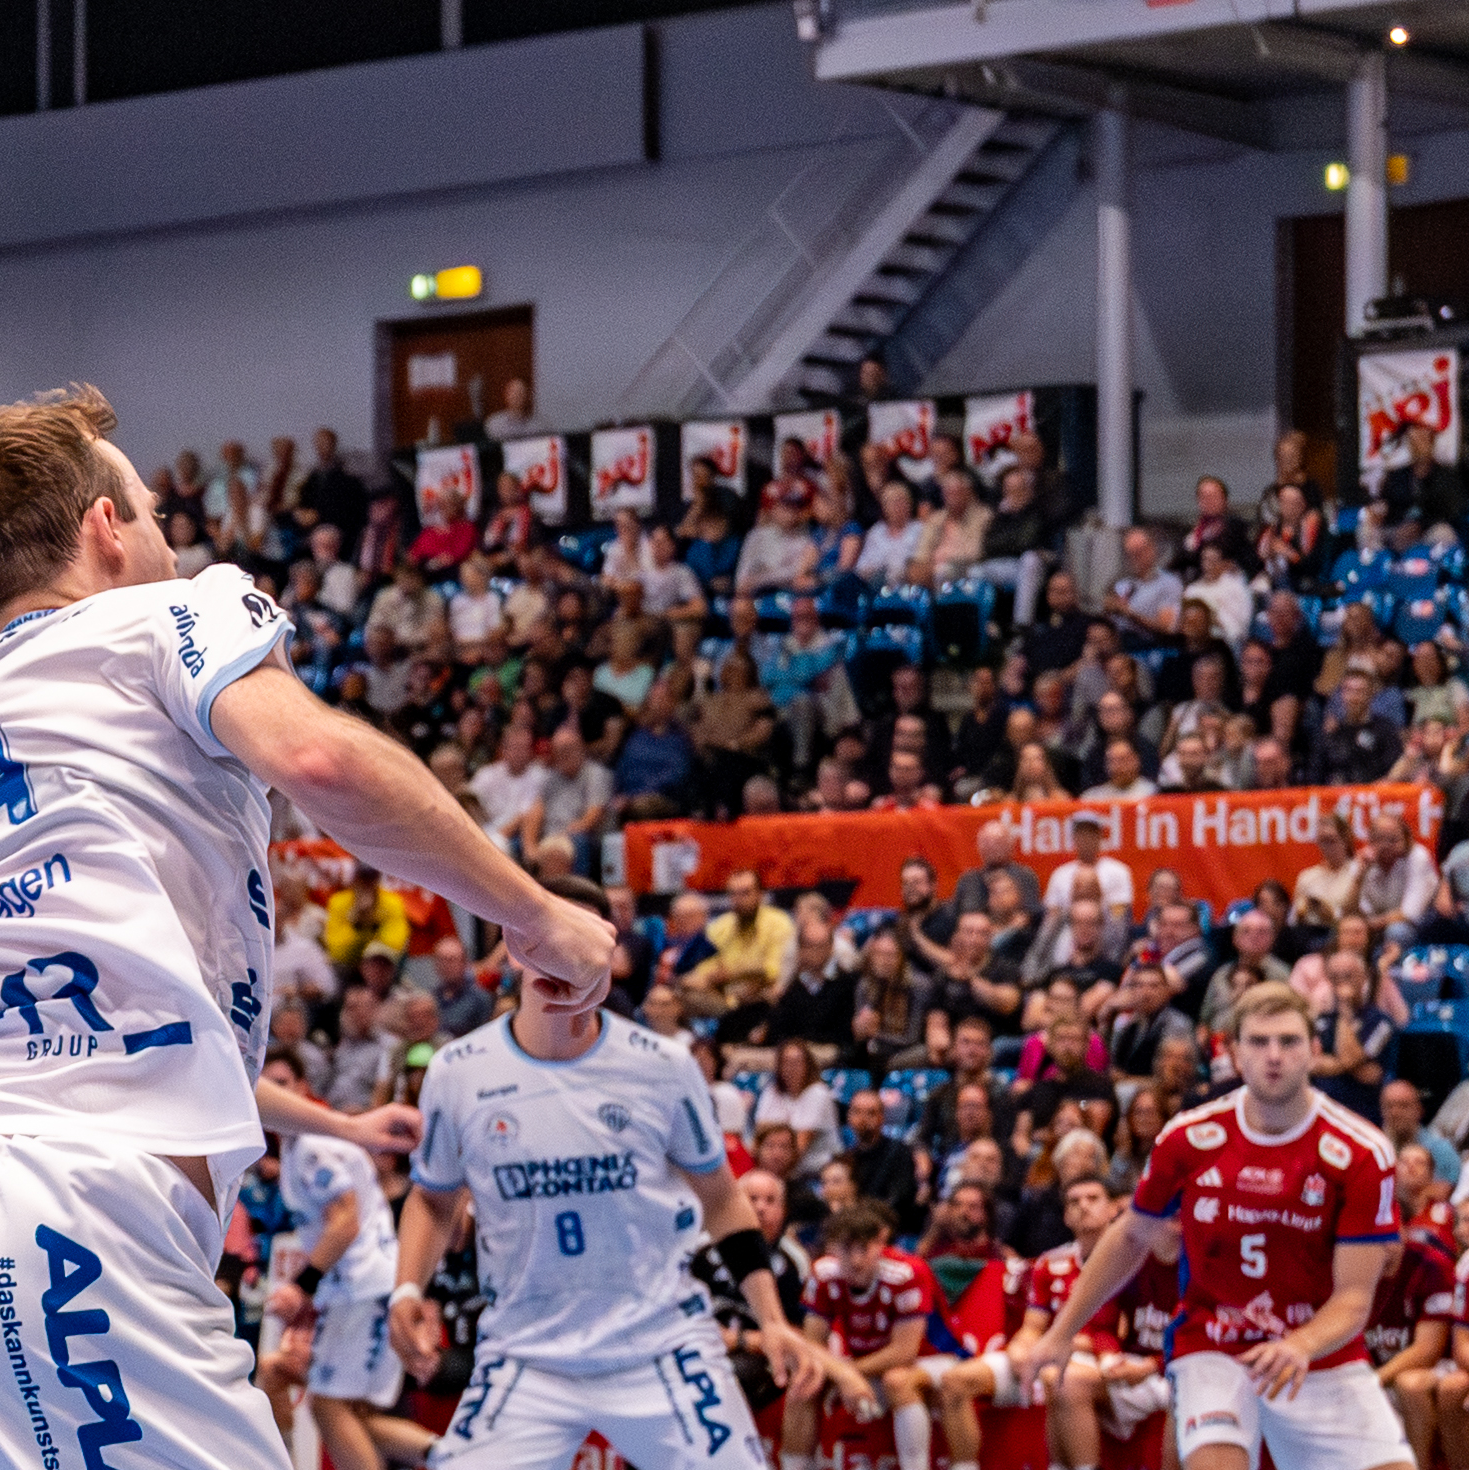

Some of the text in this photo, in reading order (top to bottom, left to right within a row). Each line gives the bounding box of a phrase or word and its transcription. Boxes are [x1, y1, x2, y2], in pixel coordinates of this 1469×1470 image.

[1136, 801, 1180, 850] in
[1192, 794, 1320, 848] Hand
[555, 1210, 586, 1257] 8
[1240, 1233, 1268, 1280] 5
